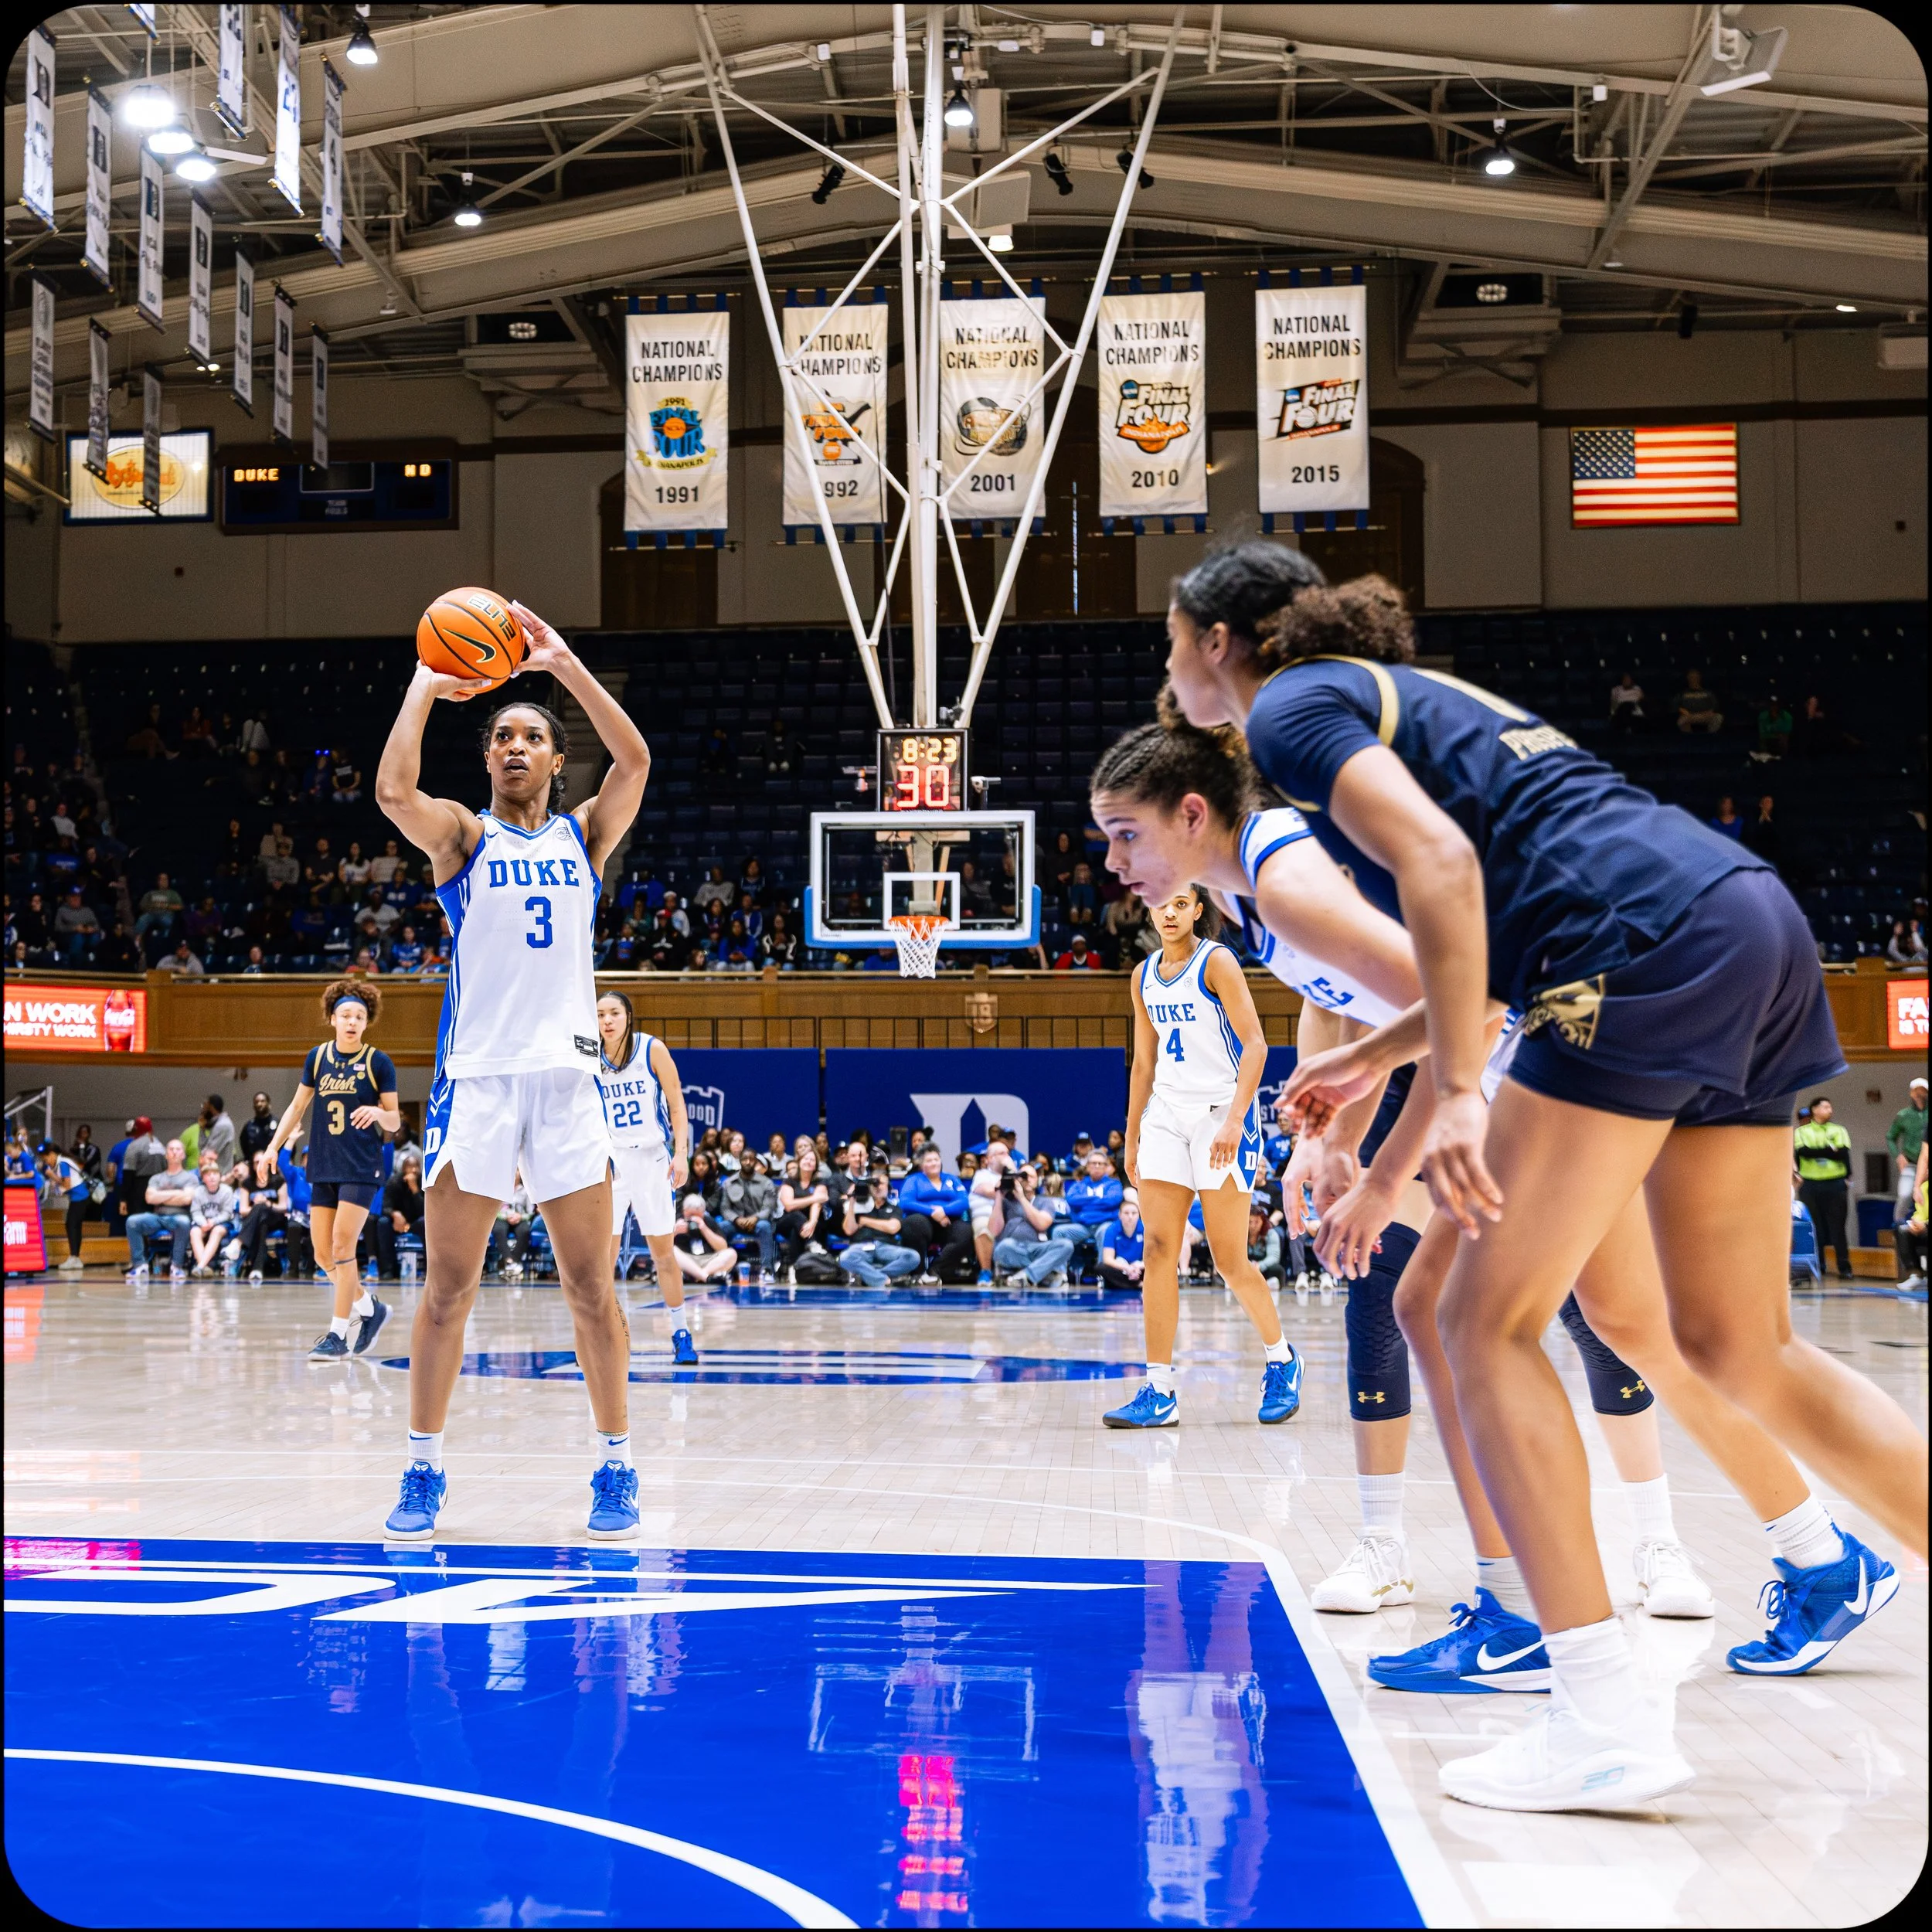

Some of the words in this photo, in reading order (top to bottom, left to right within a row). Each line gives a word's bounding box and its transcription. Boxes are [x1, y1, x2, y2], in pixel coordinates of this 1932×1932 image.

[955, 325, 1031, 345] NATIONAL
[1114, 320, 1189, 341] NATIONAL
[1274, 315, 1351, 335] NATIONAL
[641, 340, 715, 359] NATIONAL
[947, 349, 1039, 369] CHAMPIONS
[1106, 345, 1199, 366] CHAMPIONS
[1264, 338, 1361, 360] CHAMPIONS
[632, 363, 723, 383] CHAMPIONS
[1138, 385, 1192, 406] FINAL
[1303, 383, 1355, 406] FINAL
[1117, 400, 1192, 429] FOUR
[234, 468, 279, 482] DUKE
[971, 474, 1015, 492] 2001
[1131, 468, 1179, 488] 2010
[1291, 465, 1340, 484] 2015
[655, 485, 699, 504] 1991
[824, 479, 859, 498] 992
[468, 594, 517, 642] ELITE
[902, 737, 957, 764] 8:23
[896, 764, 950, 808] 30
[488, 859, 580, 888] DUKE
[525, 896, 553, 949] 3
[26, 1002, 97, 1024] WORK
[1148, 1003, 1196, 1024] DUKE
[1898, 997, 1930, 1020] FA
[53, 1024, 97, 1039] WORK
[1166, 1028, 1185, 1063] 4
[318, 1073, 357, 1097] Irish
[603, 1080, 647, 1100] DUKE
[327, 1100, 345, 1135] 3
[613, 1100, 644, 1128] 22
[424, 1127, 441, 1157] D
[1244, 1151, 1257, 1171] D
